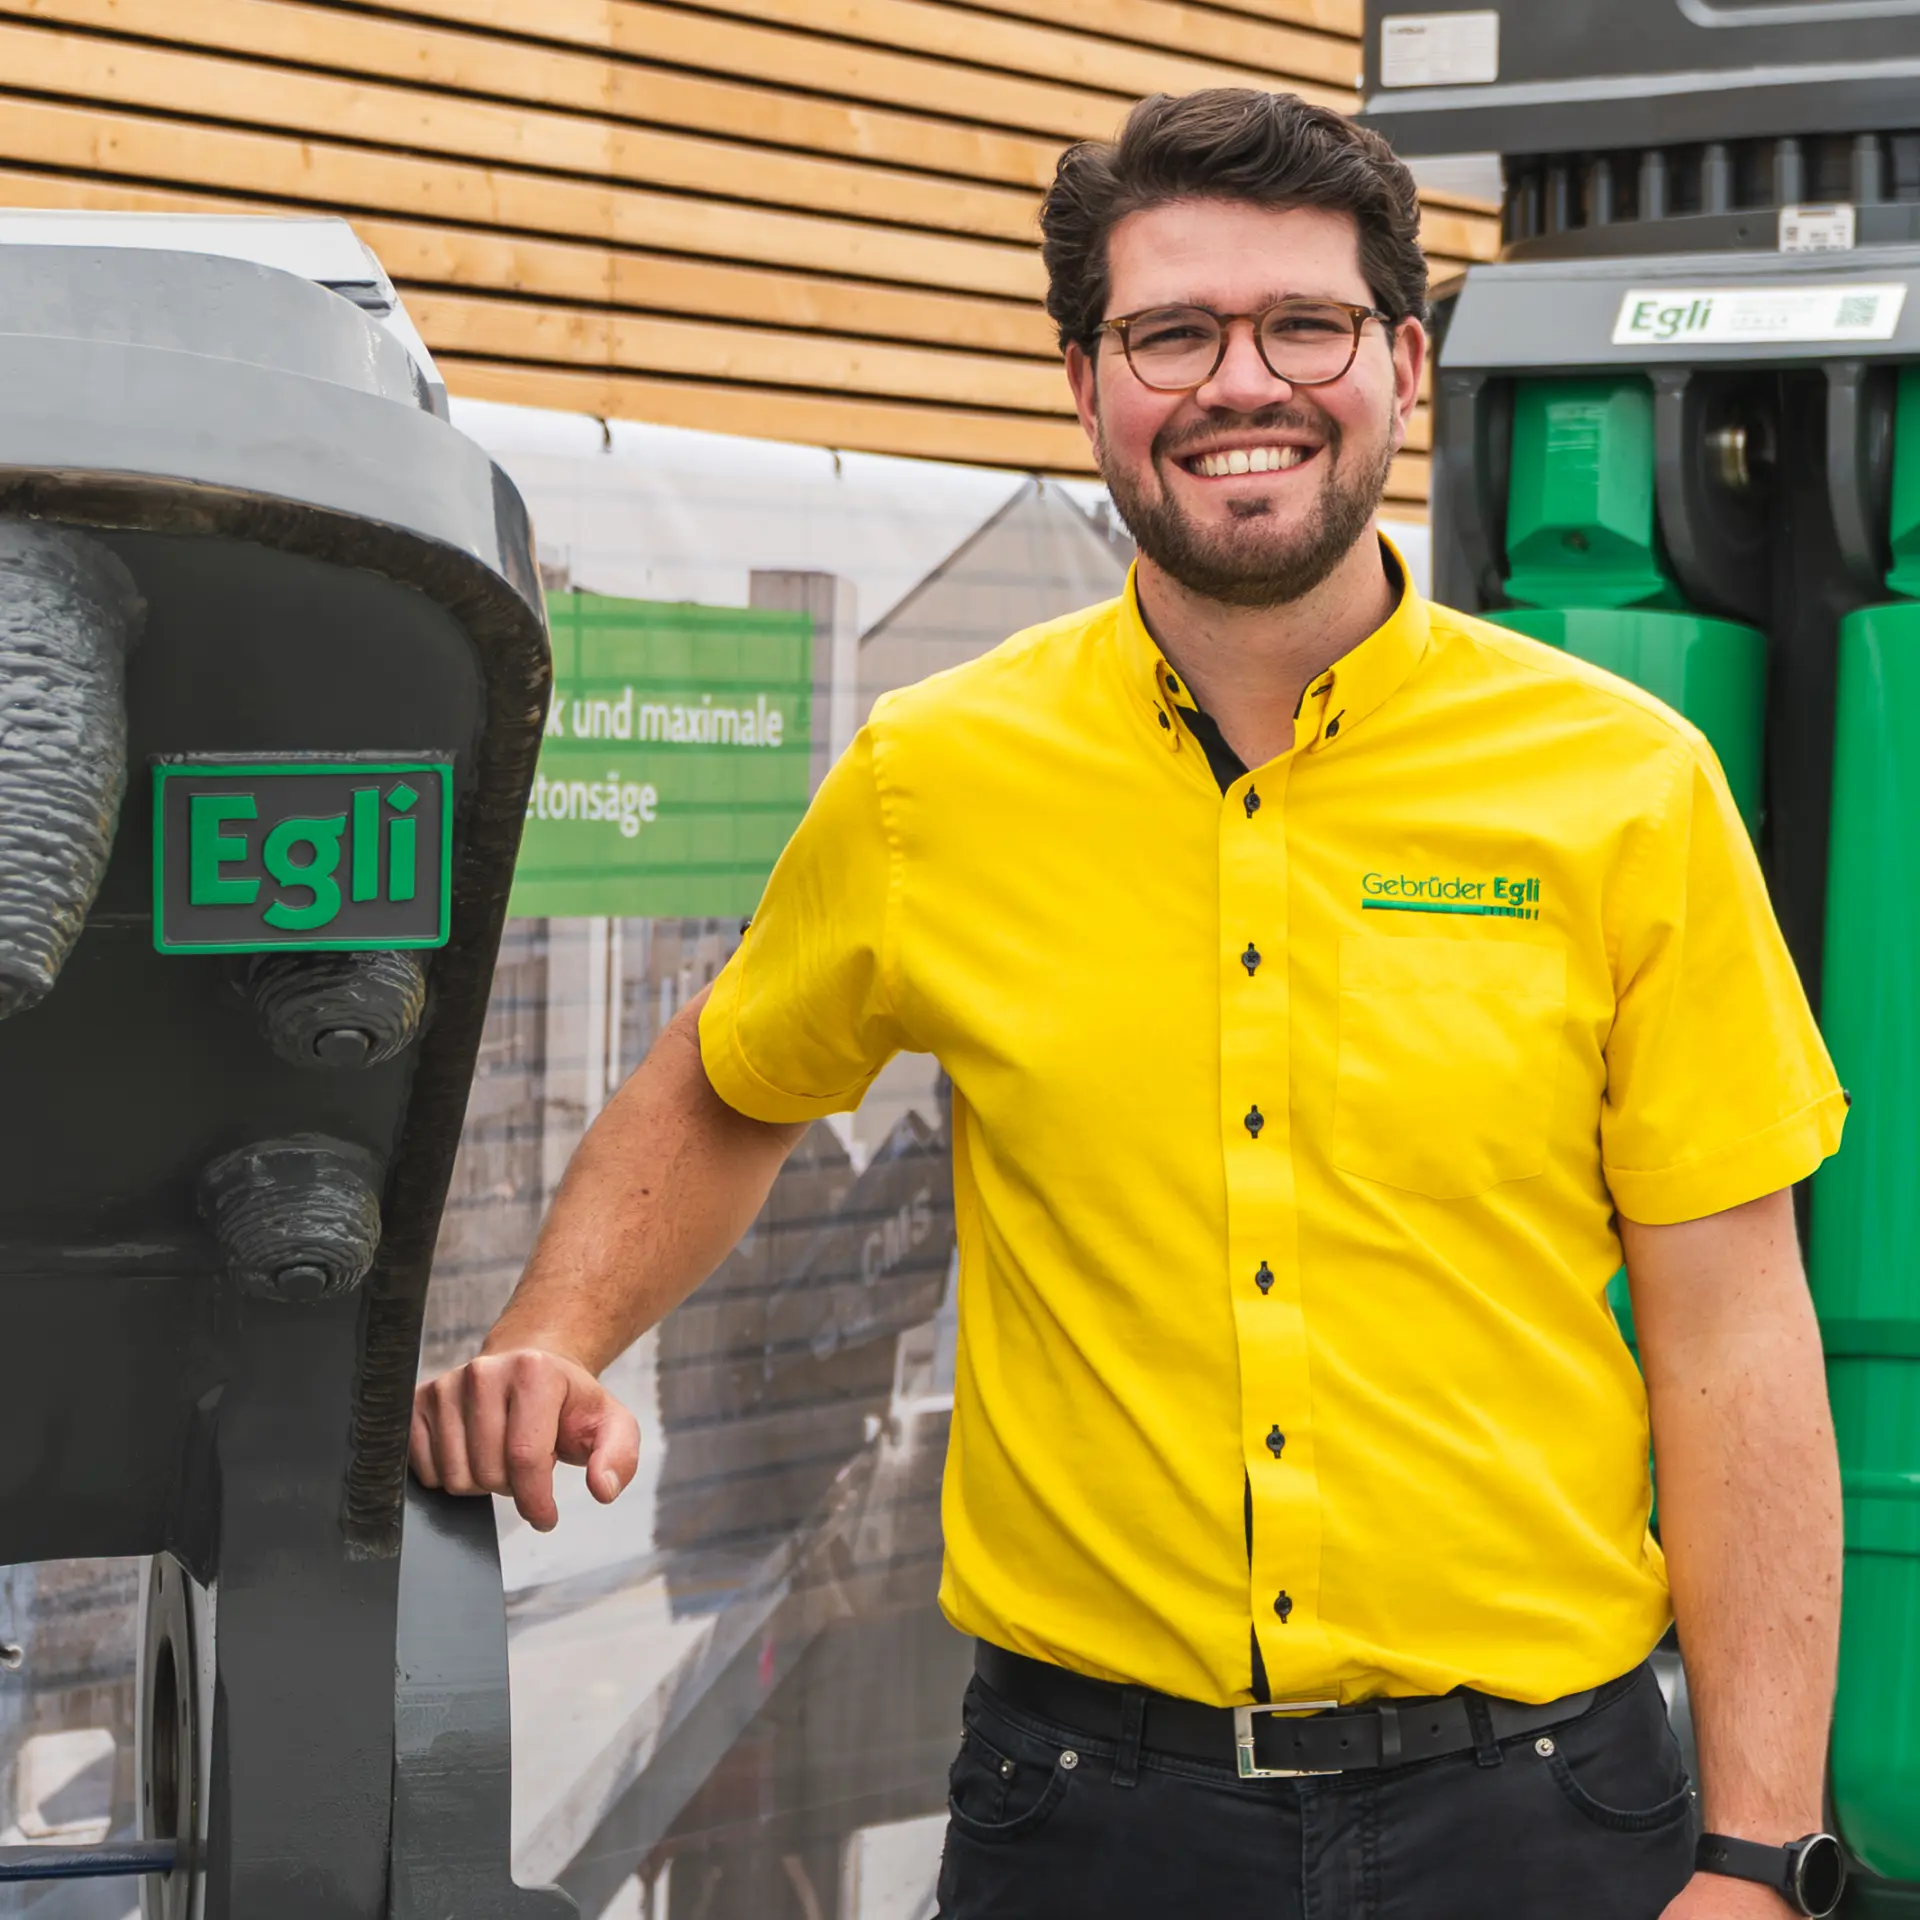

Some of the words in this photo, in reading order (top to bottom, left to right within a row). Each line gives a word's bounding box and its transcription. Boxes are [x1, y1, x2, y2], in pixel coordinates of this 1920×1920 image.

[1630, 298, 1714, 339] Egli
[573, 686, 633, 740] und
[639, 692, 783, 748] maximale
[189, 784, 419, 930] Egli
[1362, 872, 1486, 900] Gebrüder
[1493, 876, 1541, 906] Egli
